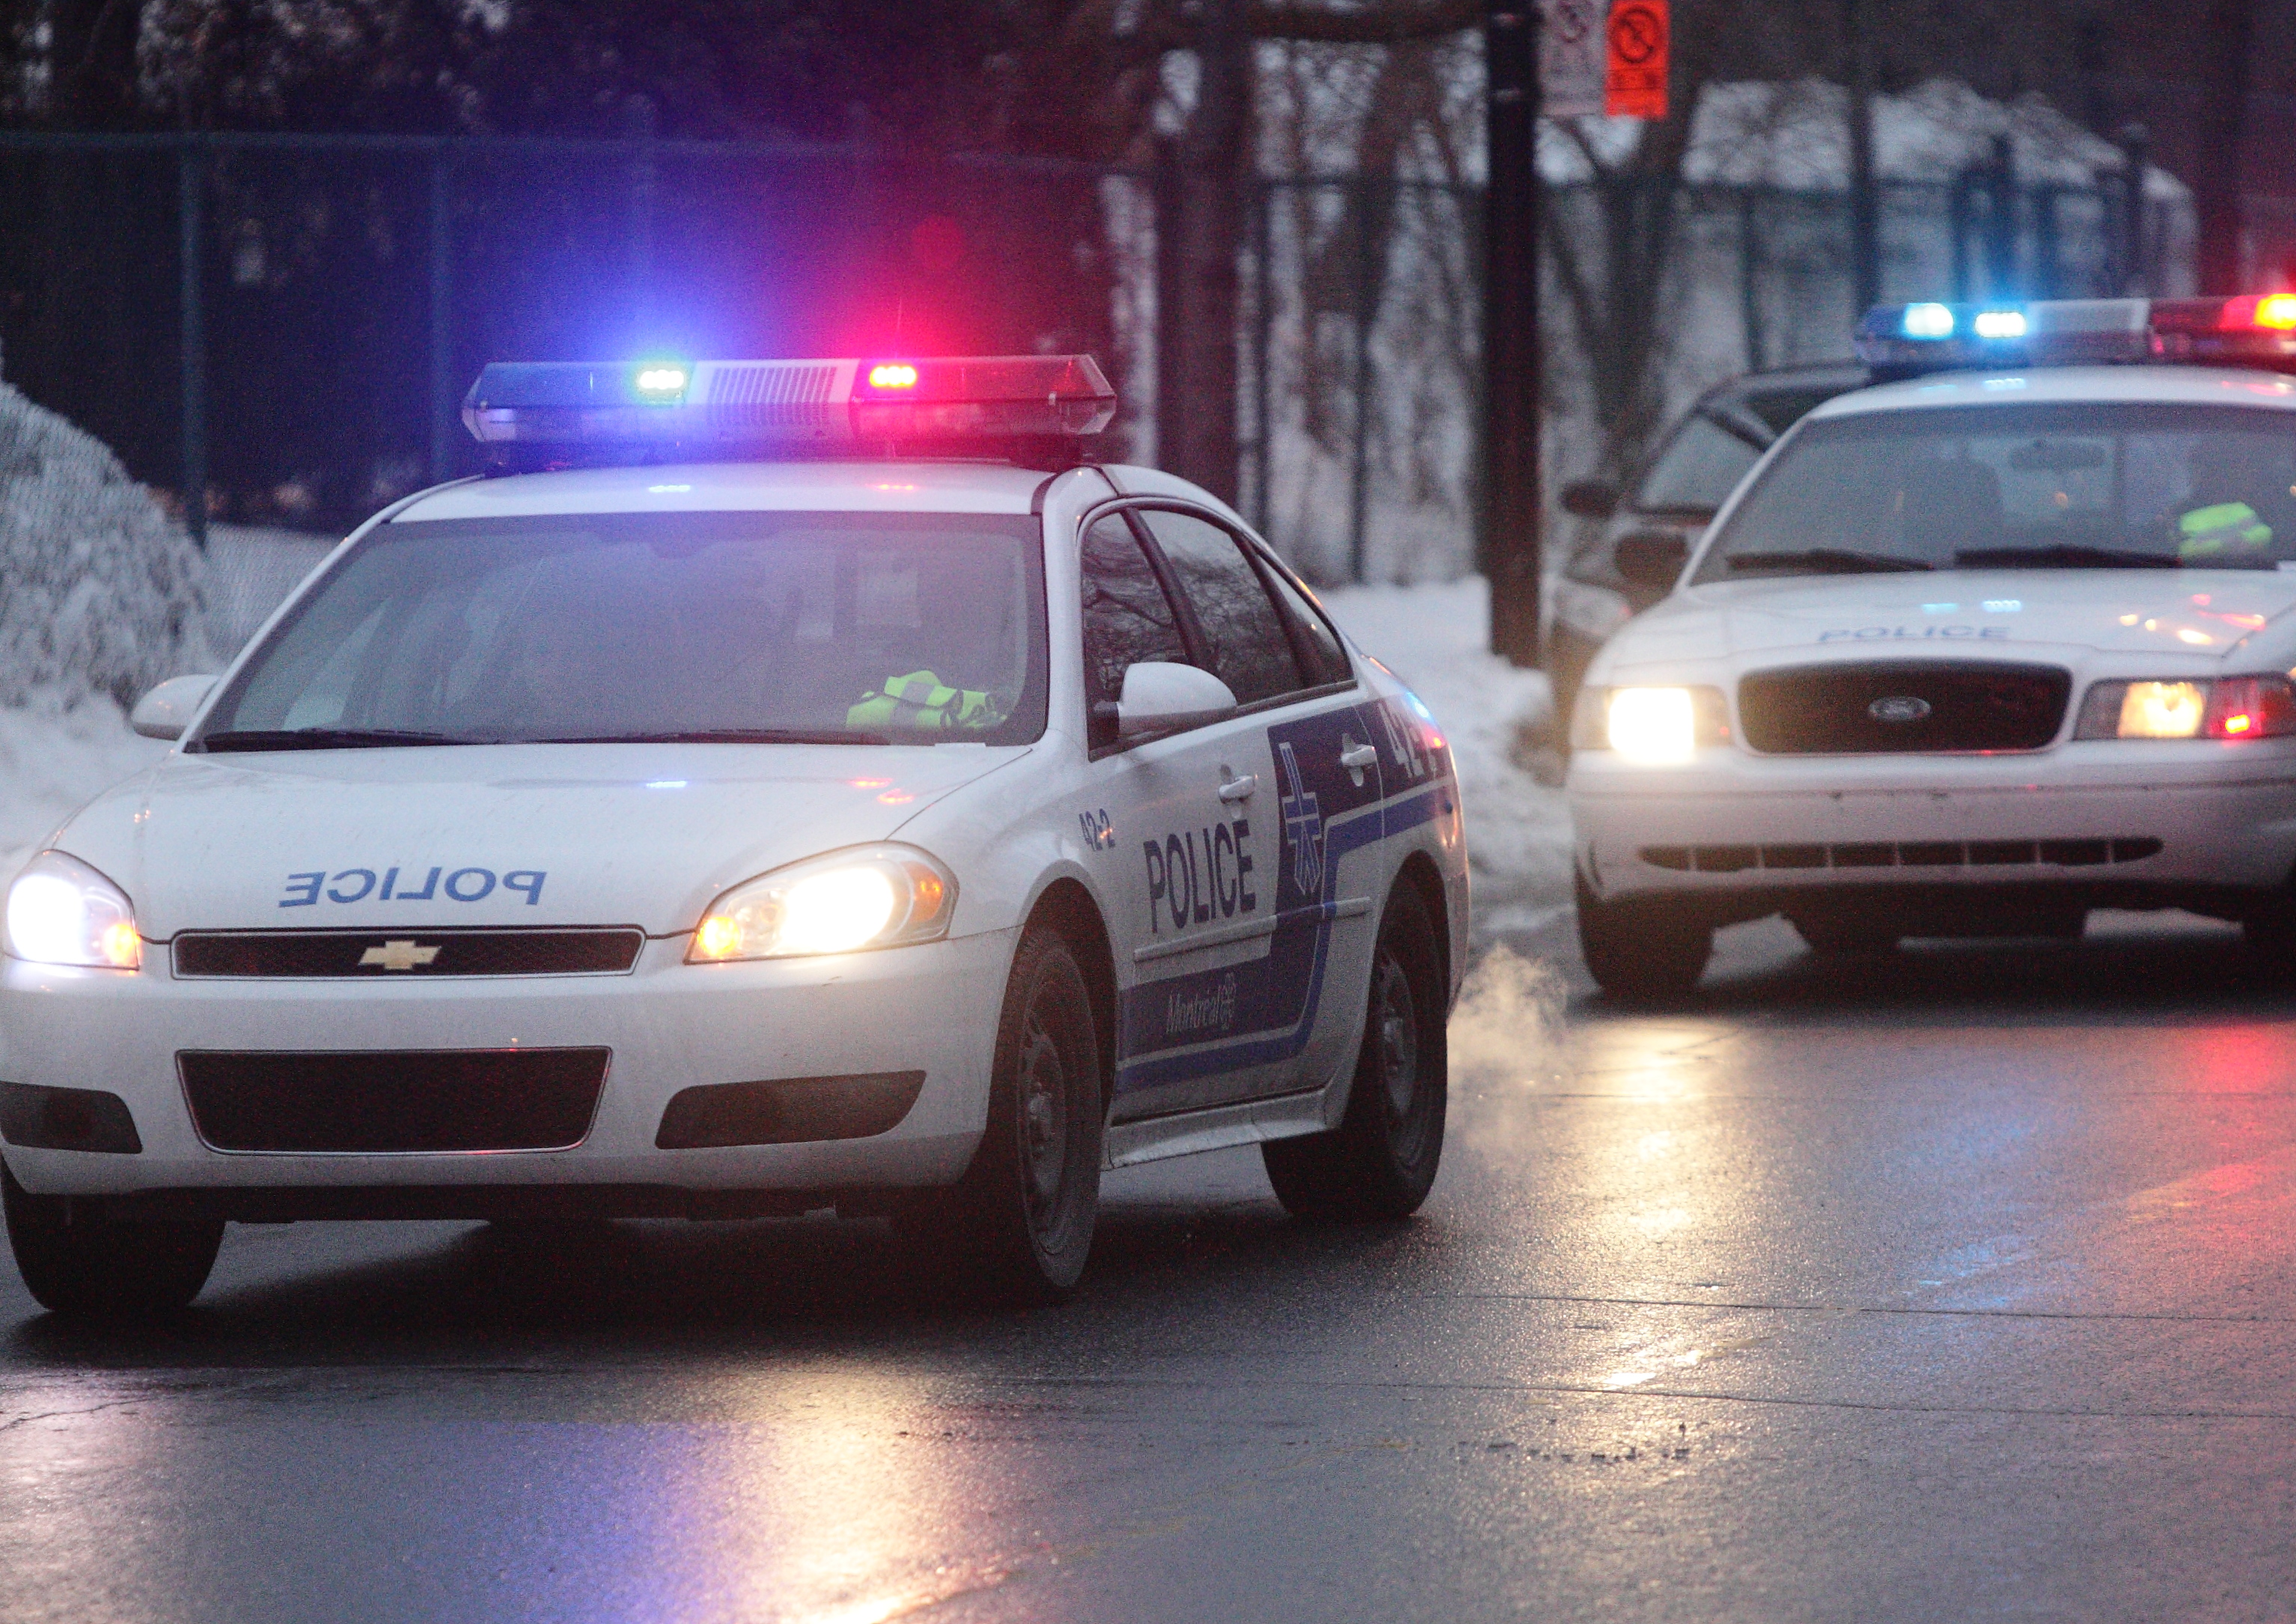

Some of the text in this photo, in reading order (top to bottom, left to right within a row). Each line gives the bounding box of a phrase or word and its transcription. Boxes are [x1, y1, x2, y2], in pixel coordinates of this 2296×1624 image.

[1818, 626, 2011, 642] POLICE
[1078, 808, 1116, 852] 42-2
[1144, 819, 1257, 934] POLICE
[1166, 985, 1221, 1034] Montréal
